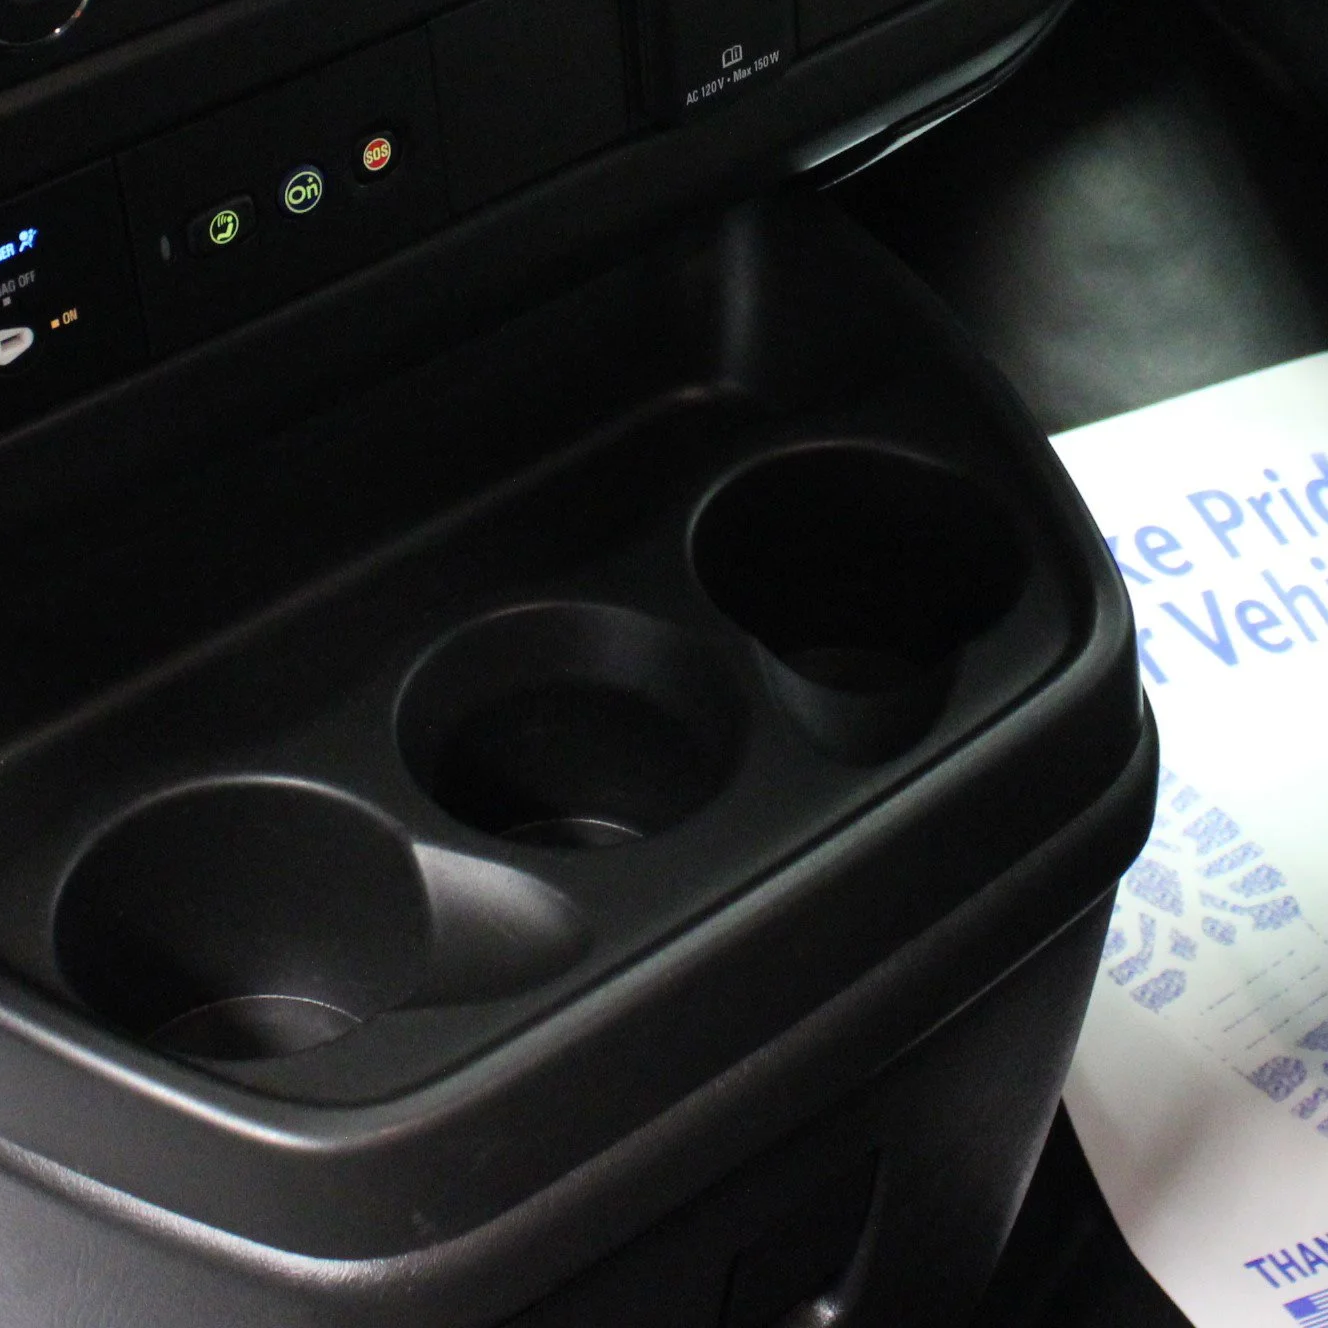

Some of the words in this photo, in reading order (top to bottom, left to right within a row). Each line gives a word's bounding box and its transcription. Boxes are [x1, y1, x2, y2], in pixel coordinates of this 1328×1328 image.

[686, 89, 699, 106] AC
[733, 66, 752, 83] Max
[365, 143, 389, 164] SOS
[18, 270, 35, 288] OFF
[62, 308, 78, 325] ON
